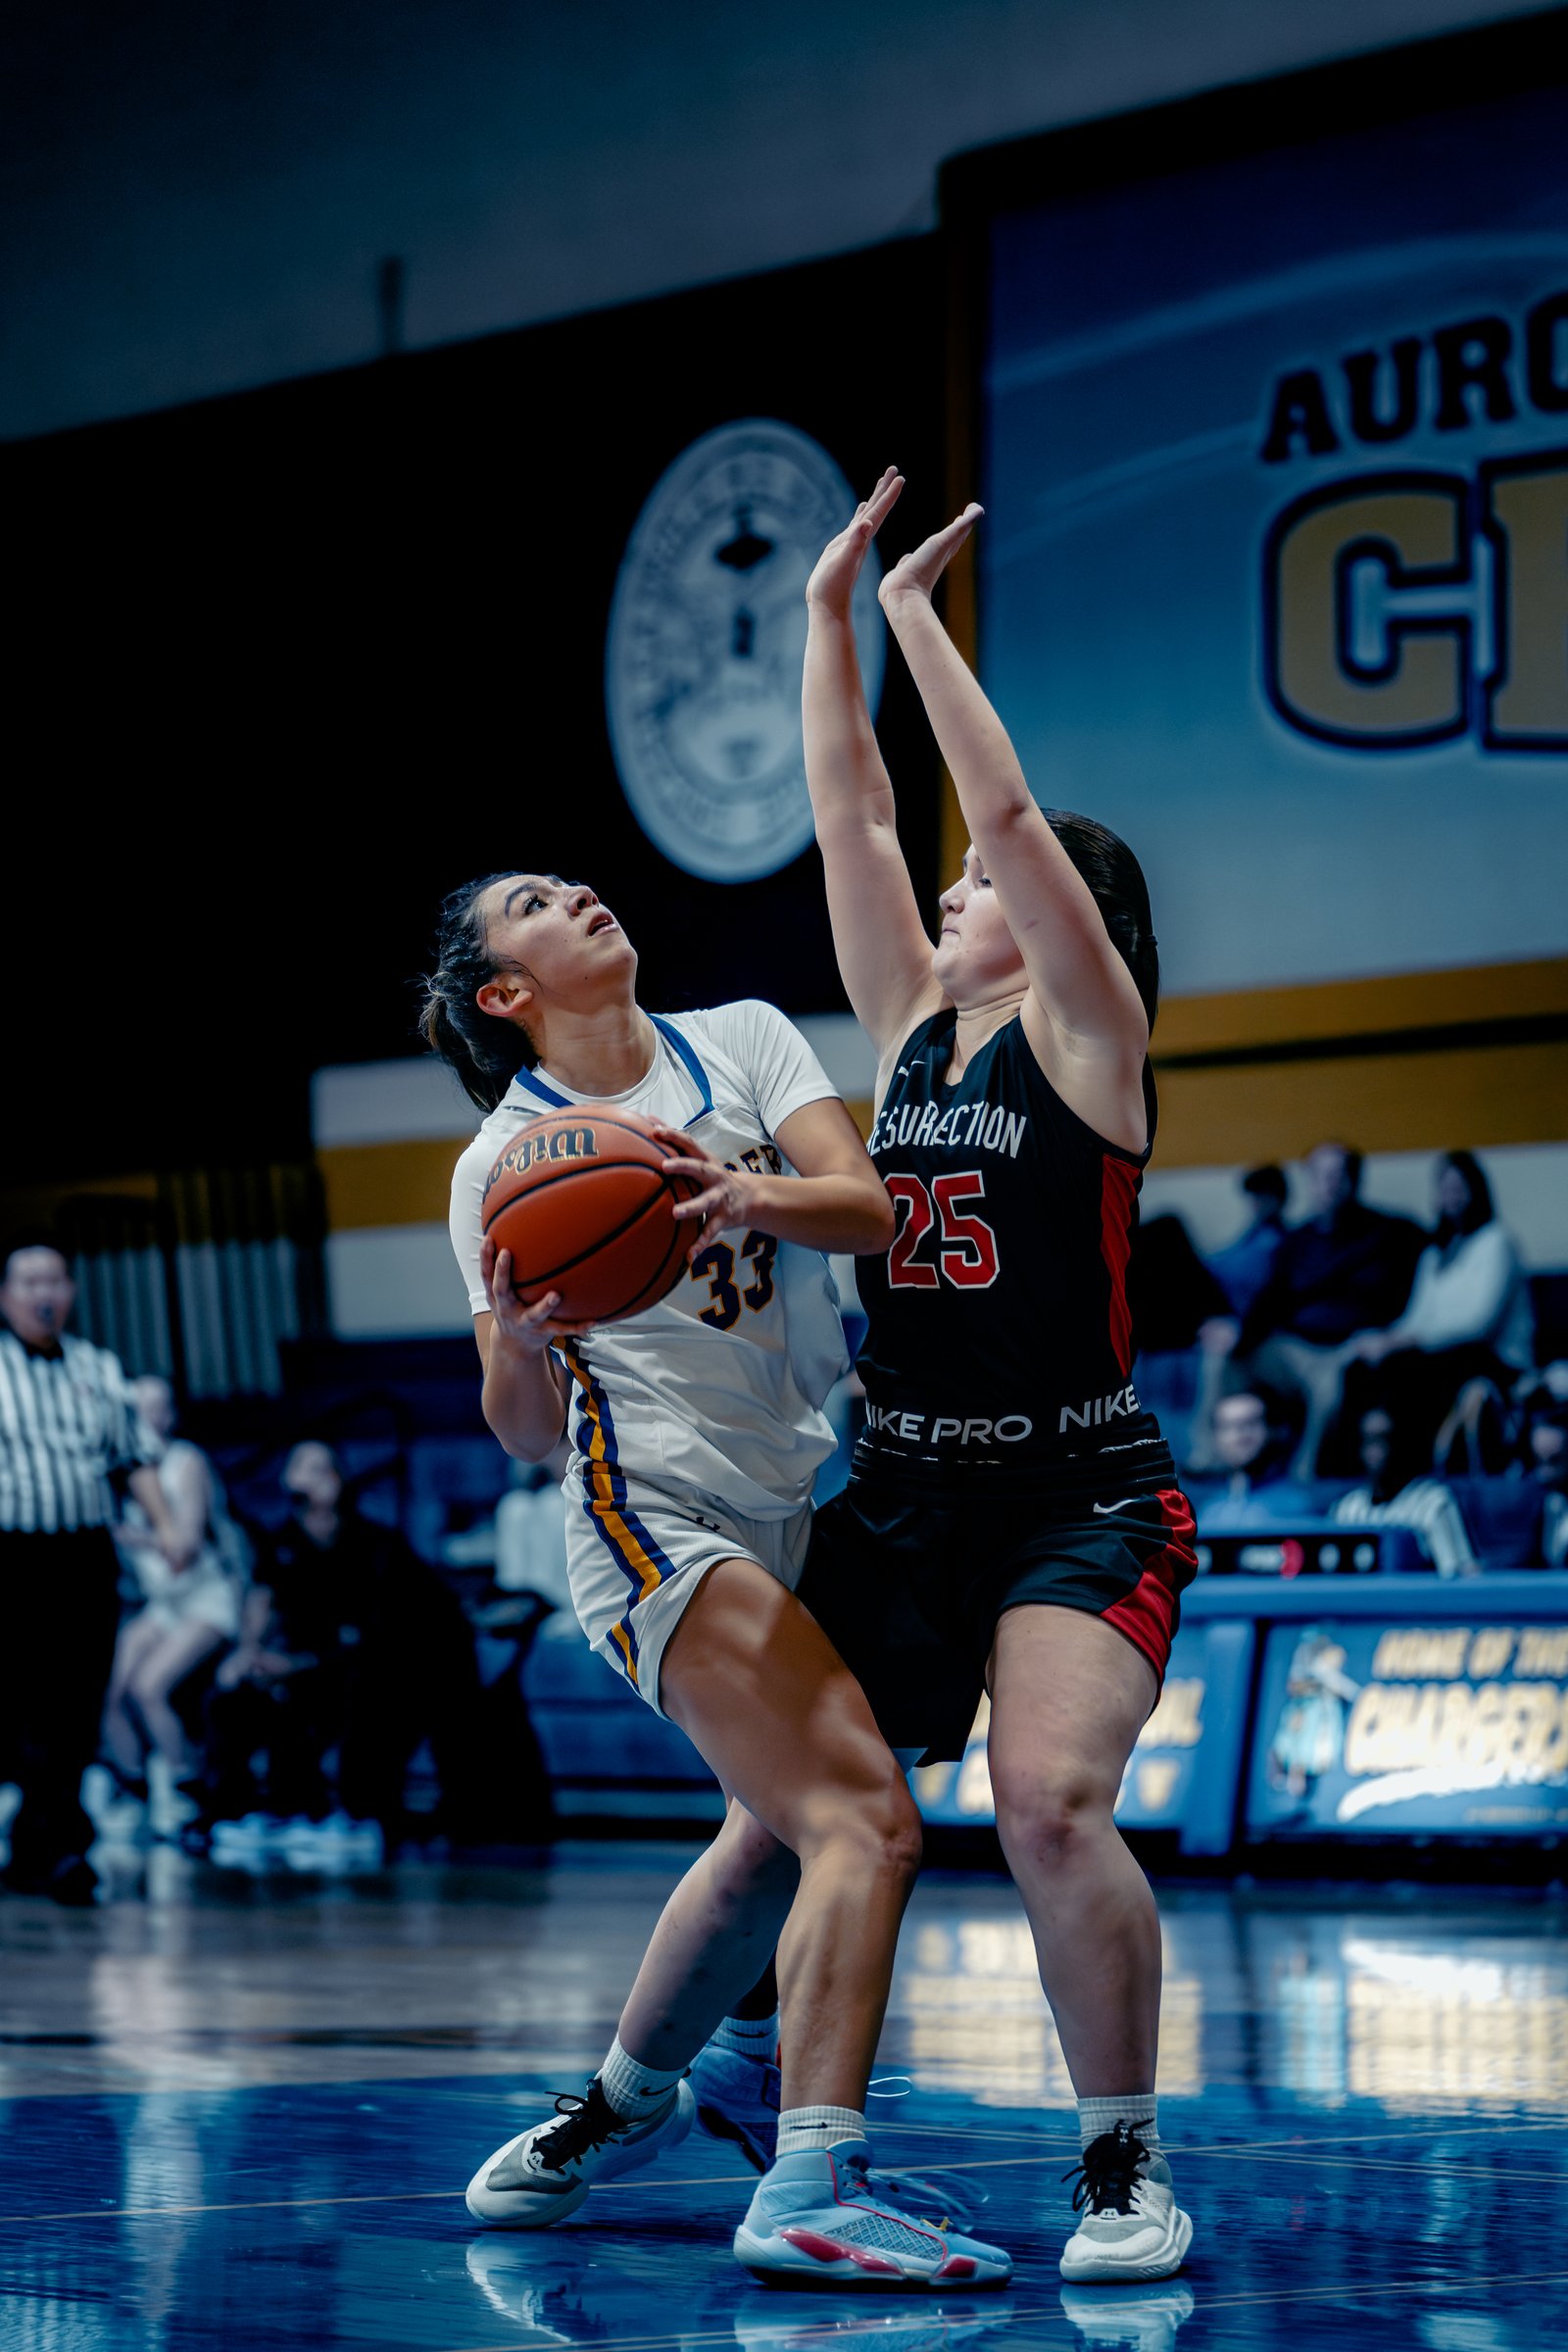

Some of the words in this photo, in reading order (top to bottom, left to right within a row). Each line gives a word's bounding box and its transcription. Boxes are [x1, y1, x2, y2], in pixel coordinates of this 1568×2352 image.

[691, 1229, 779, 1332] 33
[883, 1170, 1001, 1290] 25
[930, 1414, 1033, 1446] PRO
[1058, 1384, 1140, 1434] NIKE
